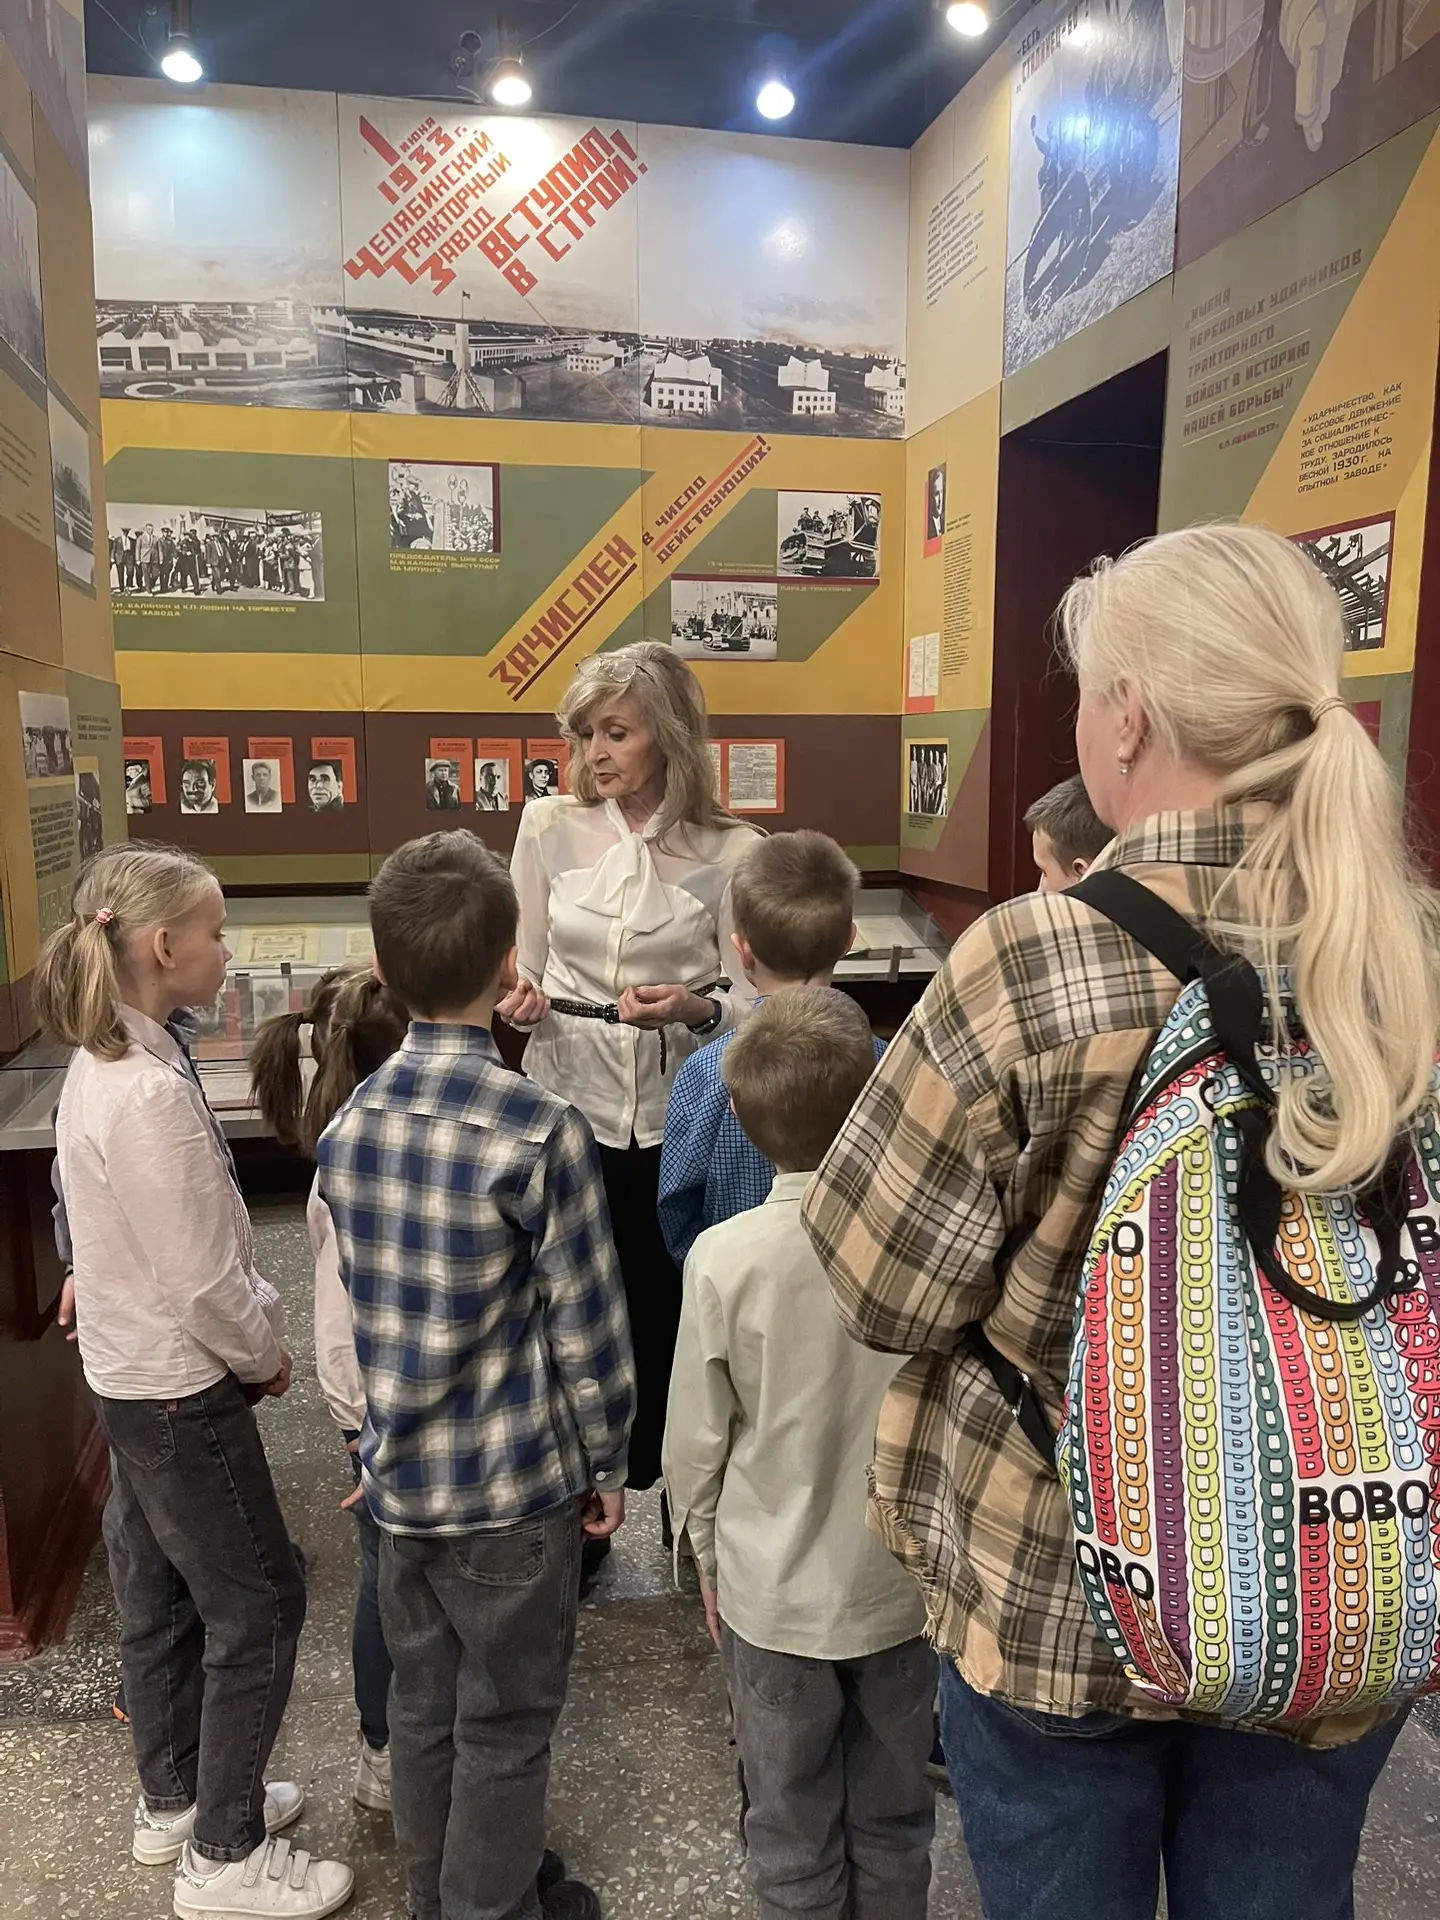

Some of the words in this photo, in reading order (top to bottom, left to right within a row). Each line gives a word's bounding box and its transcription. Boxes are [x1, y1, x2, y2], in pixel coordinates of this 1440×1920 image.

[359, 115, 400, 166] 1
[377, 125, 455, 205] 1933
[343, 129, 494, 280] ЧЕЛЯБИНСКИЙ
[383, 150, 512, 285] ТРАКТОРНЫЙ
[477, 126, 615, 269] ВСТУПИЛ
[501, 258, 538, 297] В
[536, 129, 648, 262] СТРОЙ!
[416, 206, 496, 296] ЗАВОД
[1189, 299, 1265, 350] ПЕРЕДОВЫХ
[1269, 249, 1362, 308] УДАРНИКОВ
[1185, 376, 1229, 408] ВОЙДУТ
[1232, 373, 1240, 388] В
[1246, 341, 1310, 380] ИСТОРИЮ
[1188, 325, 1275, 378] ТРАКТОРНОГО
[1383, 381, 1402, 395] КАК
[1183, 404, 1225, 436] НАШЕЙ
[1302, 414, 1345, 436] МАССОВОЕ
[1348, 394, 1401, 421] ДВИЖЕНИЕ
[1302, 438, 1312, 448] ЗА
[1315, 411, 1395, 443] СОЦИАЛИСТИЧЕС-
[1299, 466, 1329, 482] ВЕСНОЙ
[1378, 448, 1392, 458] НА
[1301, 448, 1315, 459] КОЕ
[1318, 430, 1371, 453] ОТНОШЕНИЕ
[1374, 427, 1380, 435] К
[1332, 436, 1393, 460] ЗАРОДИЛОСЬ
[655, 475, 707, 527] ЧИСЛО
[656, 435, 772, 564] ДЕЙСТВУЮЩИХ!
[1298, 476, 1338, 493] ОПЫТНОМ
[389, 553, 457, 561] ПРЕДСЕДАТЕЛЬ
[489, 534, 637, 696] ЗАЧИСЛЕН
[1299, 1480, 1430, 1524] BOBO
